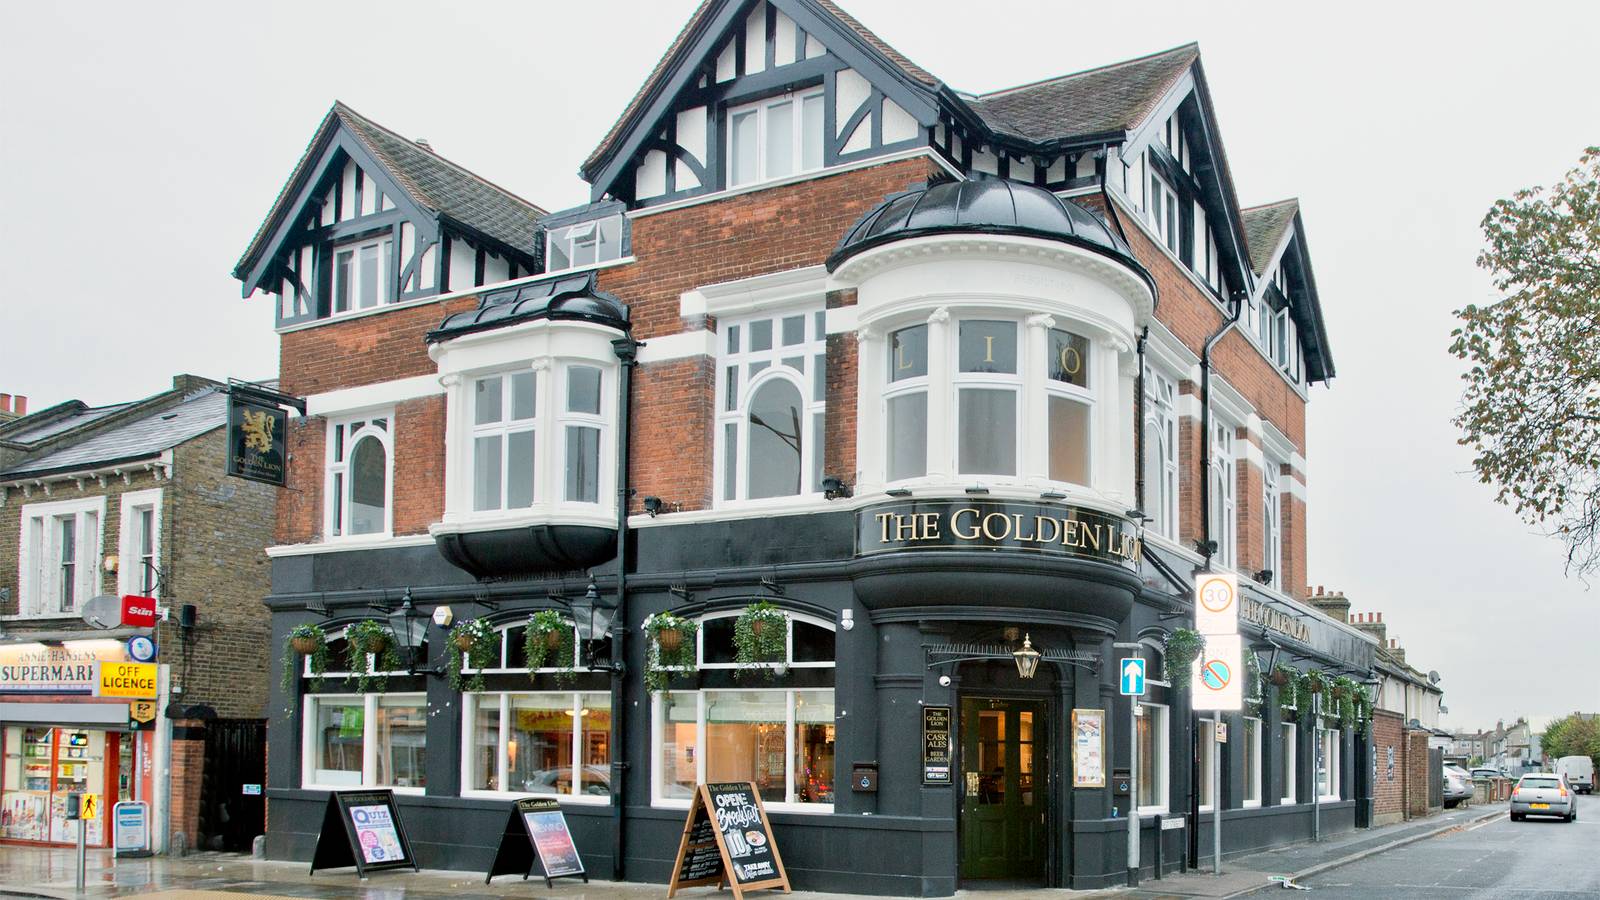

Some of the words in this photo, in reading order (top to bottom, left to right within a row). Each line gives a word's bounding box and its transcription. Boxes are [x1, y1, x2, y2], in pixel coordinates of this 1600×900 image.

[875, 511, 941, 544] THE
[950, 508, 1102, 551] GOLDEN
[1205, 588, 1229, 603] 30
[118, 665, 141, 677] OFF
[103, 676, 154, 690] LICENCE
[926, 733, 947, 741] CASK
[927, 740, 947, 748] ALES
[353, 808, 389, 824] QUIZ
